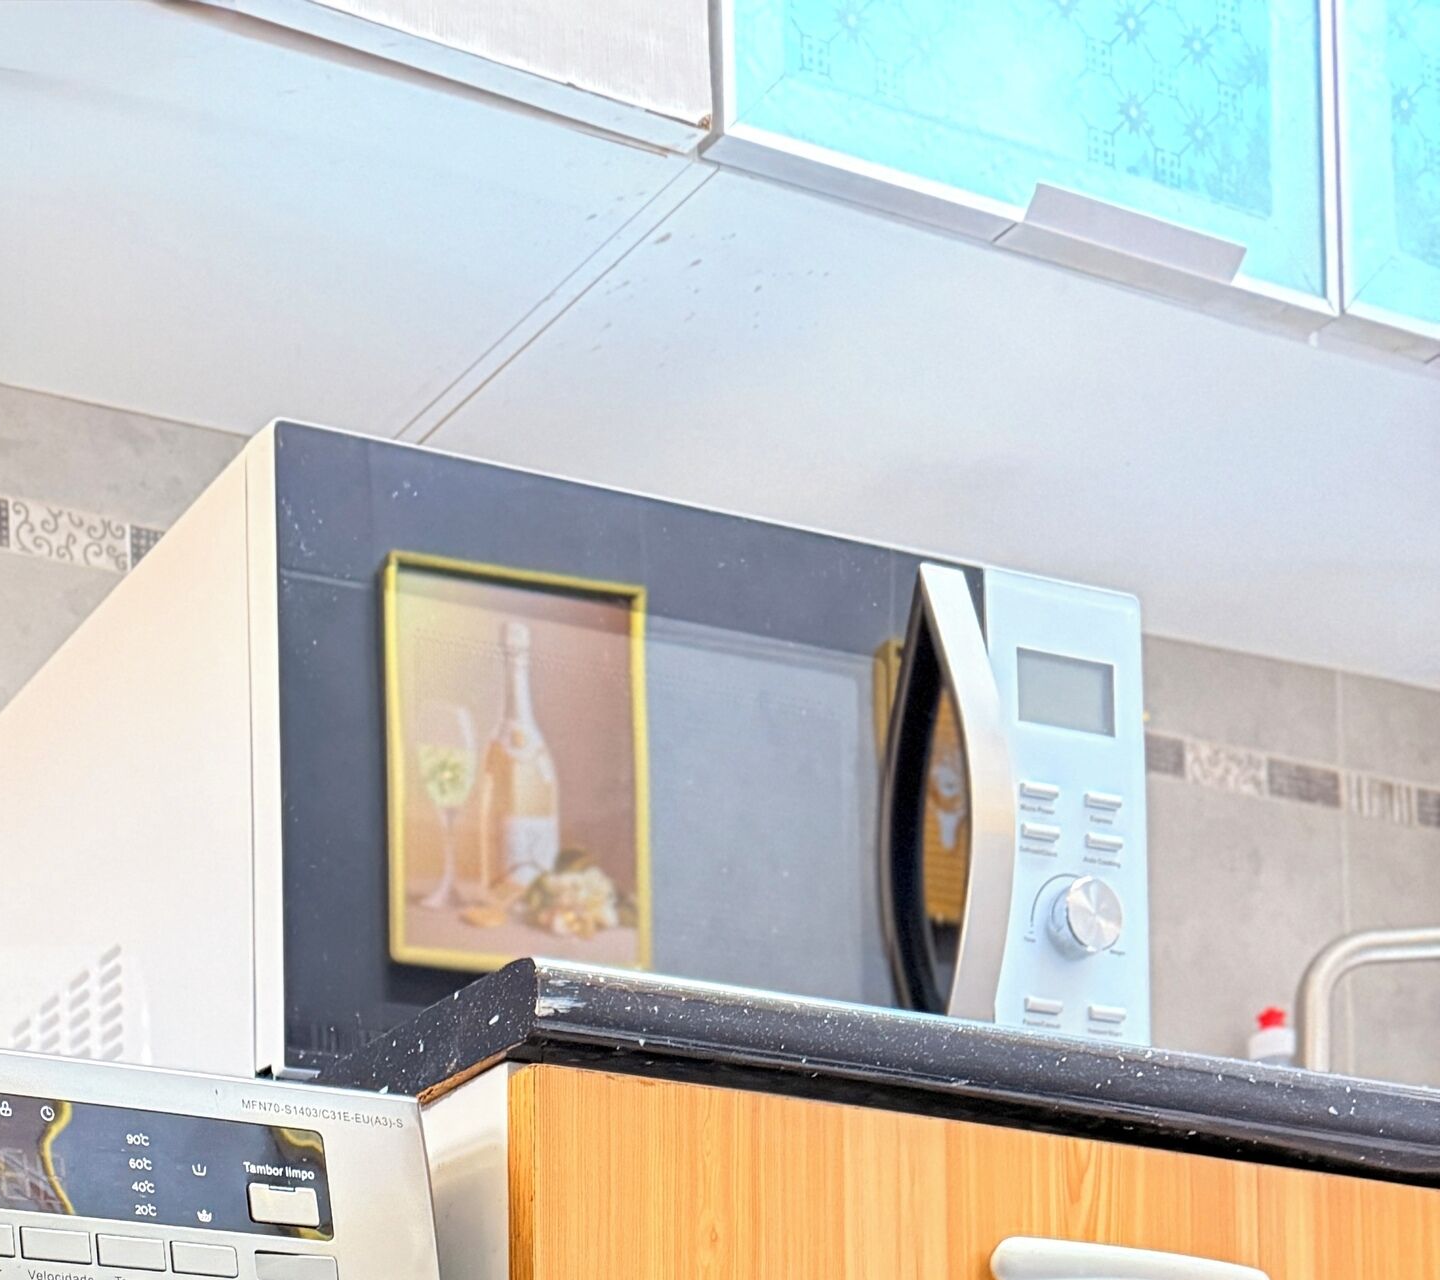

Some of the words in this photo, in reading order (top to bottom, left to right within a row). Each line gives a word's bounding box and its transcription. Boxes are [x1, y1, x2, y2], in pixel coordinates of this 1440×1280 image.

[241, 1098, 404, 1129] MFN70-S1403/C31E-EU(A3)-S
[126, 1133, 150, 1146] 90°C
[128, 1157, 152, 1171] 60°C
[243, 1161, 284, 1177] Tambor
[285, 1166, 315, 1181] limpo
[131, 1180, 155, 1194] 40°C
[135, 1203, 157, 1217] 20°C
